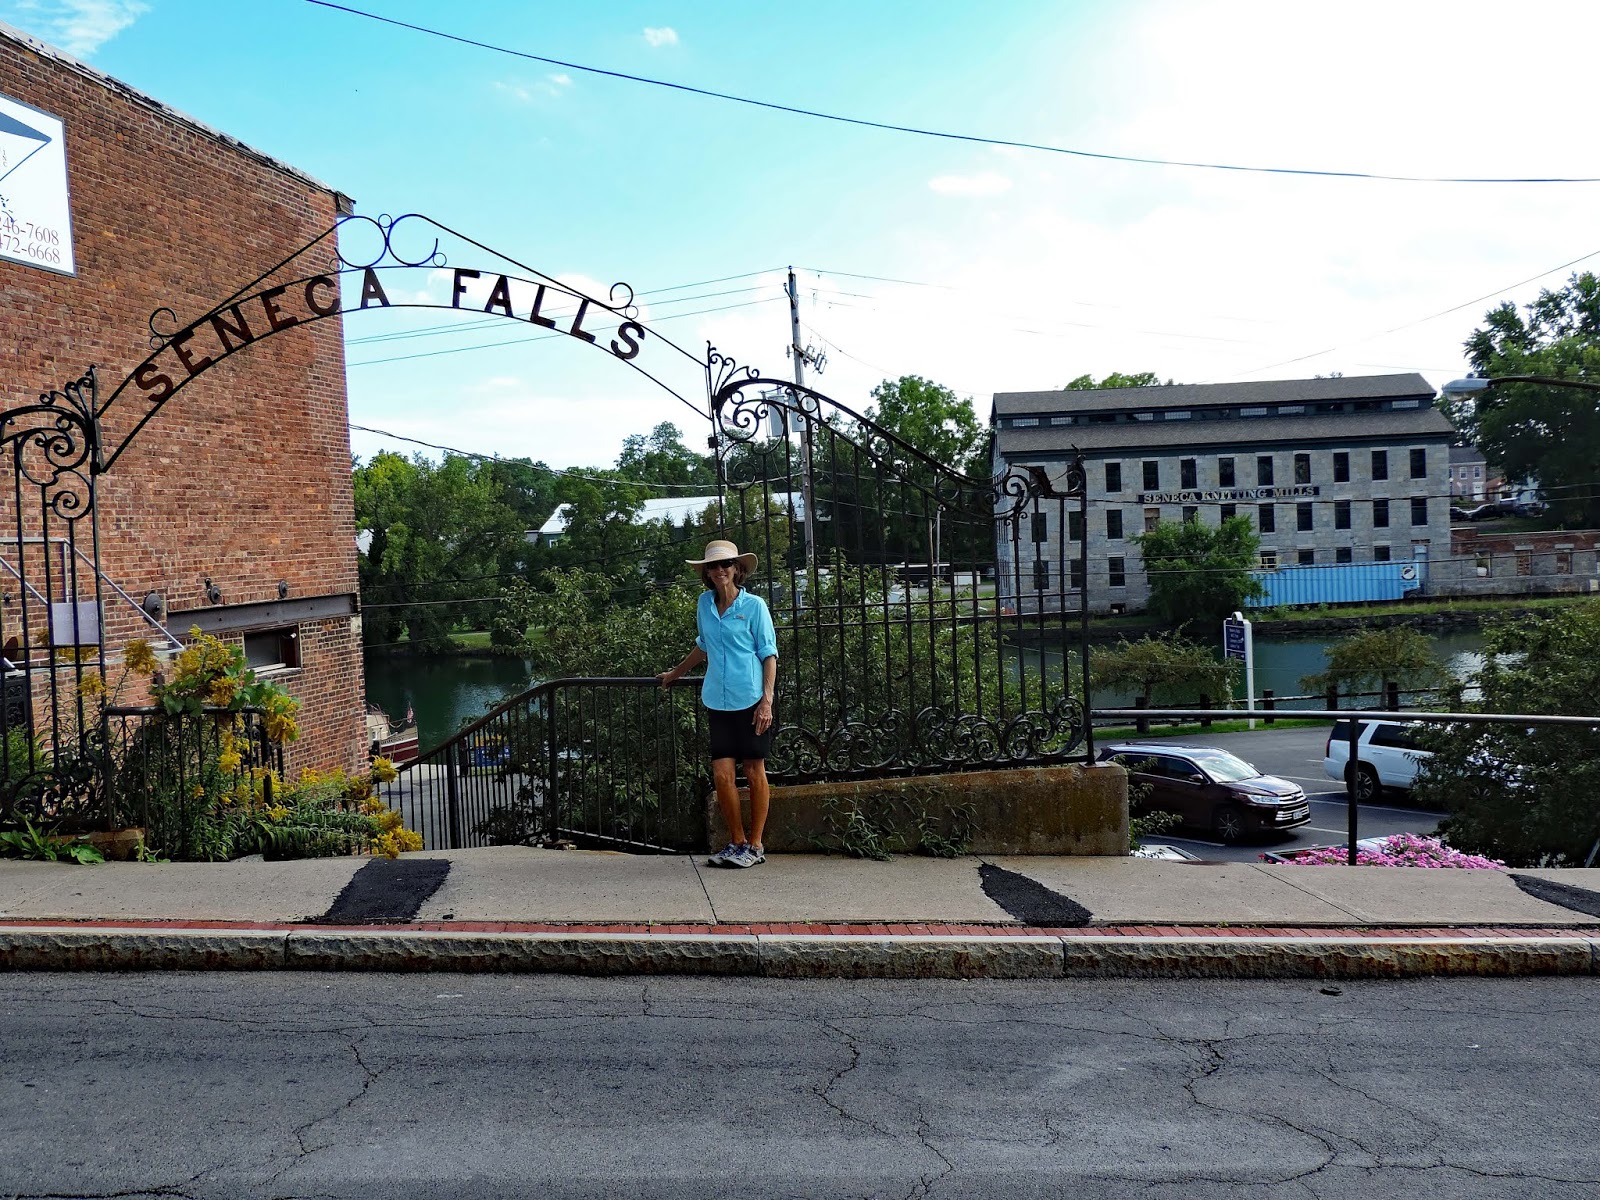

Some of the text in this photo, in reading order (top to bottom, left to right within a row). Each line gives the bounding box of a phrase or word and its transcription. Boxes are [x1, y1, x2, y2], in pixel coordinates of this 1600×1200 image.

[0, 216, 60, 246] 46-7608
[134, 268, 646, 402] SENECA FALLS
[1143, 486, 1315, 504] SENECA KNITTING MILLS
